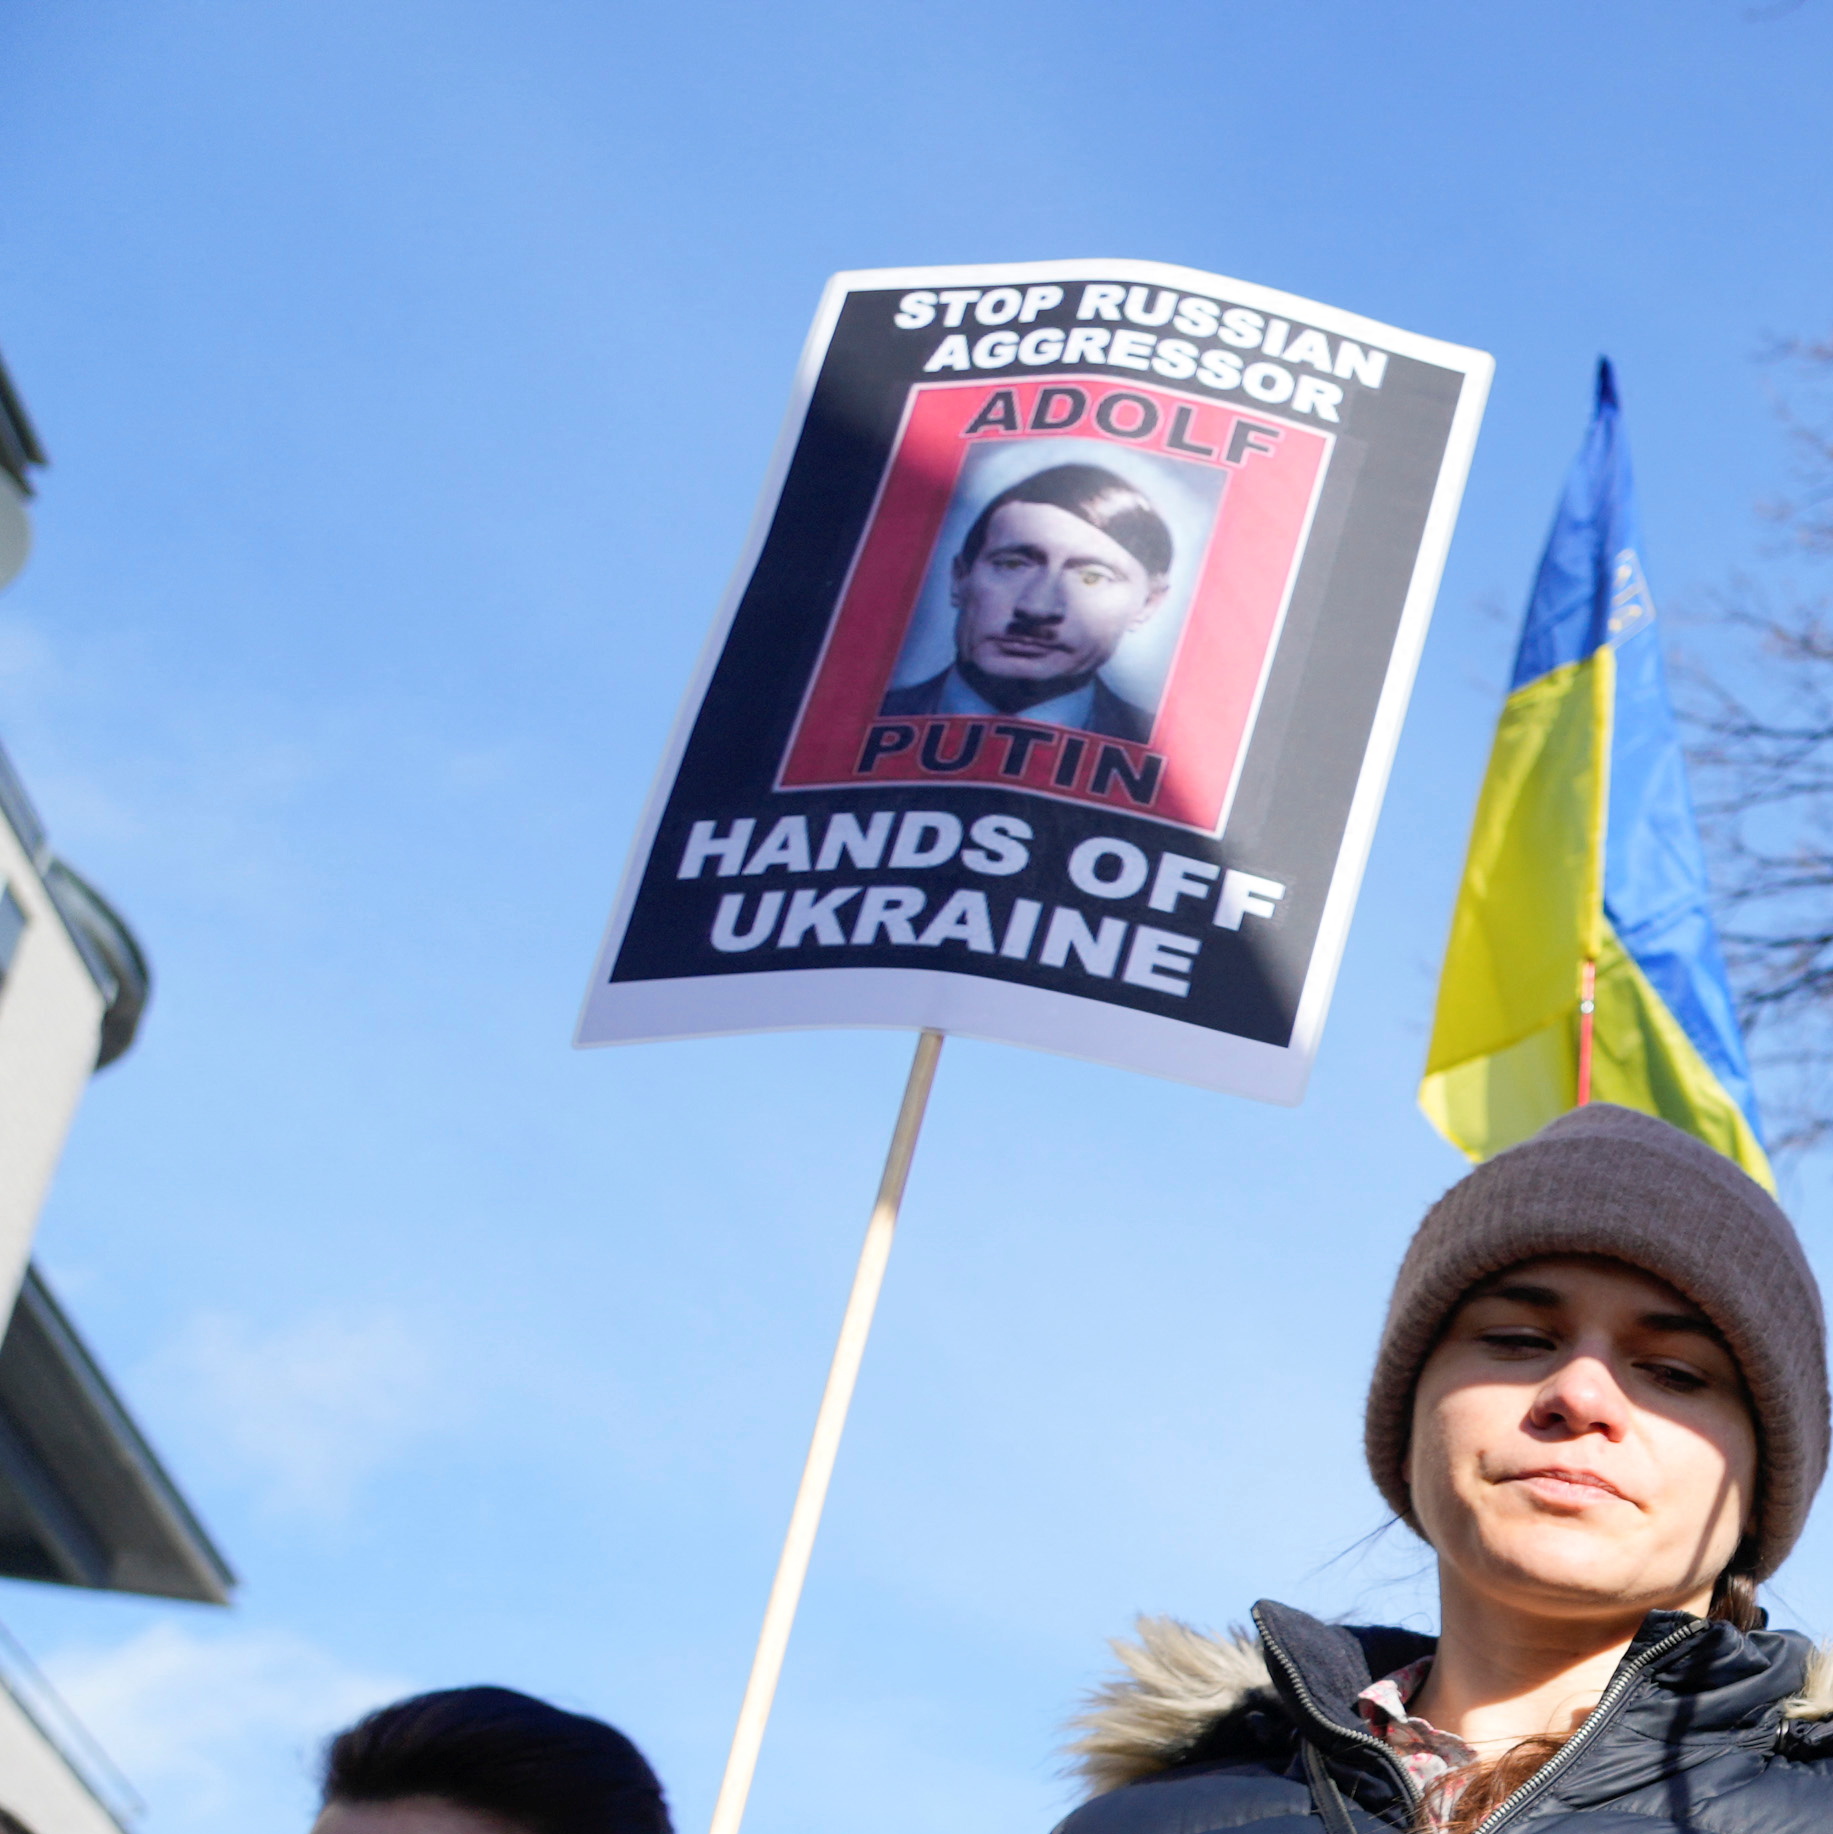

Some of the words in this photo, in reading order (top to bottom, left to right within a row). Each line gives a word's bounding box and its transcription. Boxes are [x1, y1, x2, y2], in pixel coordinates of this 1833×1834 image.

[894, 285, 1063, 330] STOP
[1077, 284, 1390, 390] RUSSIAN
[924, 331, 1345, 423] AGGRESSOR
[962, 385, 1284, 467] ADOLF
[855, 723, 1167, 806] PUTIN
[676, 809, 1032, 880] HANDS
[1068, 838, 1286, 932] OFF
[710, 884, 1200, 998] UKRAINE
